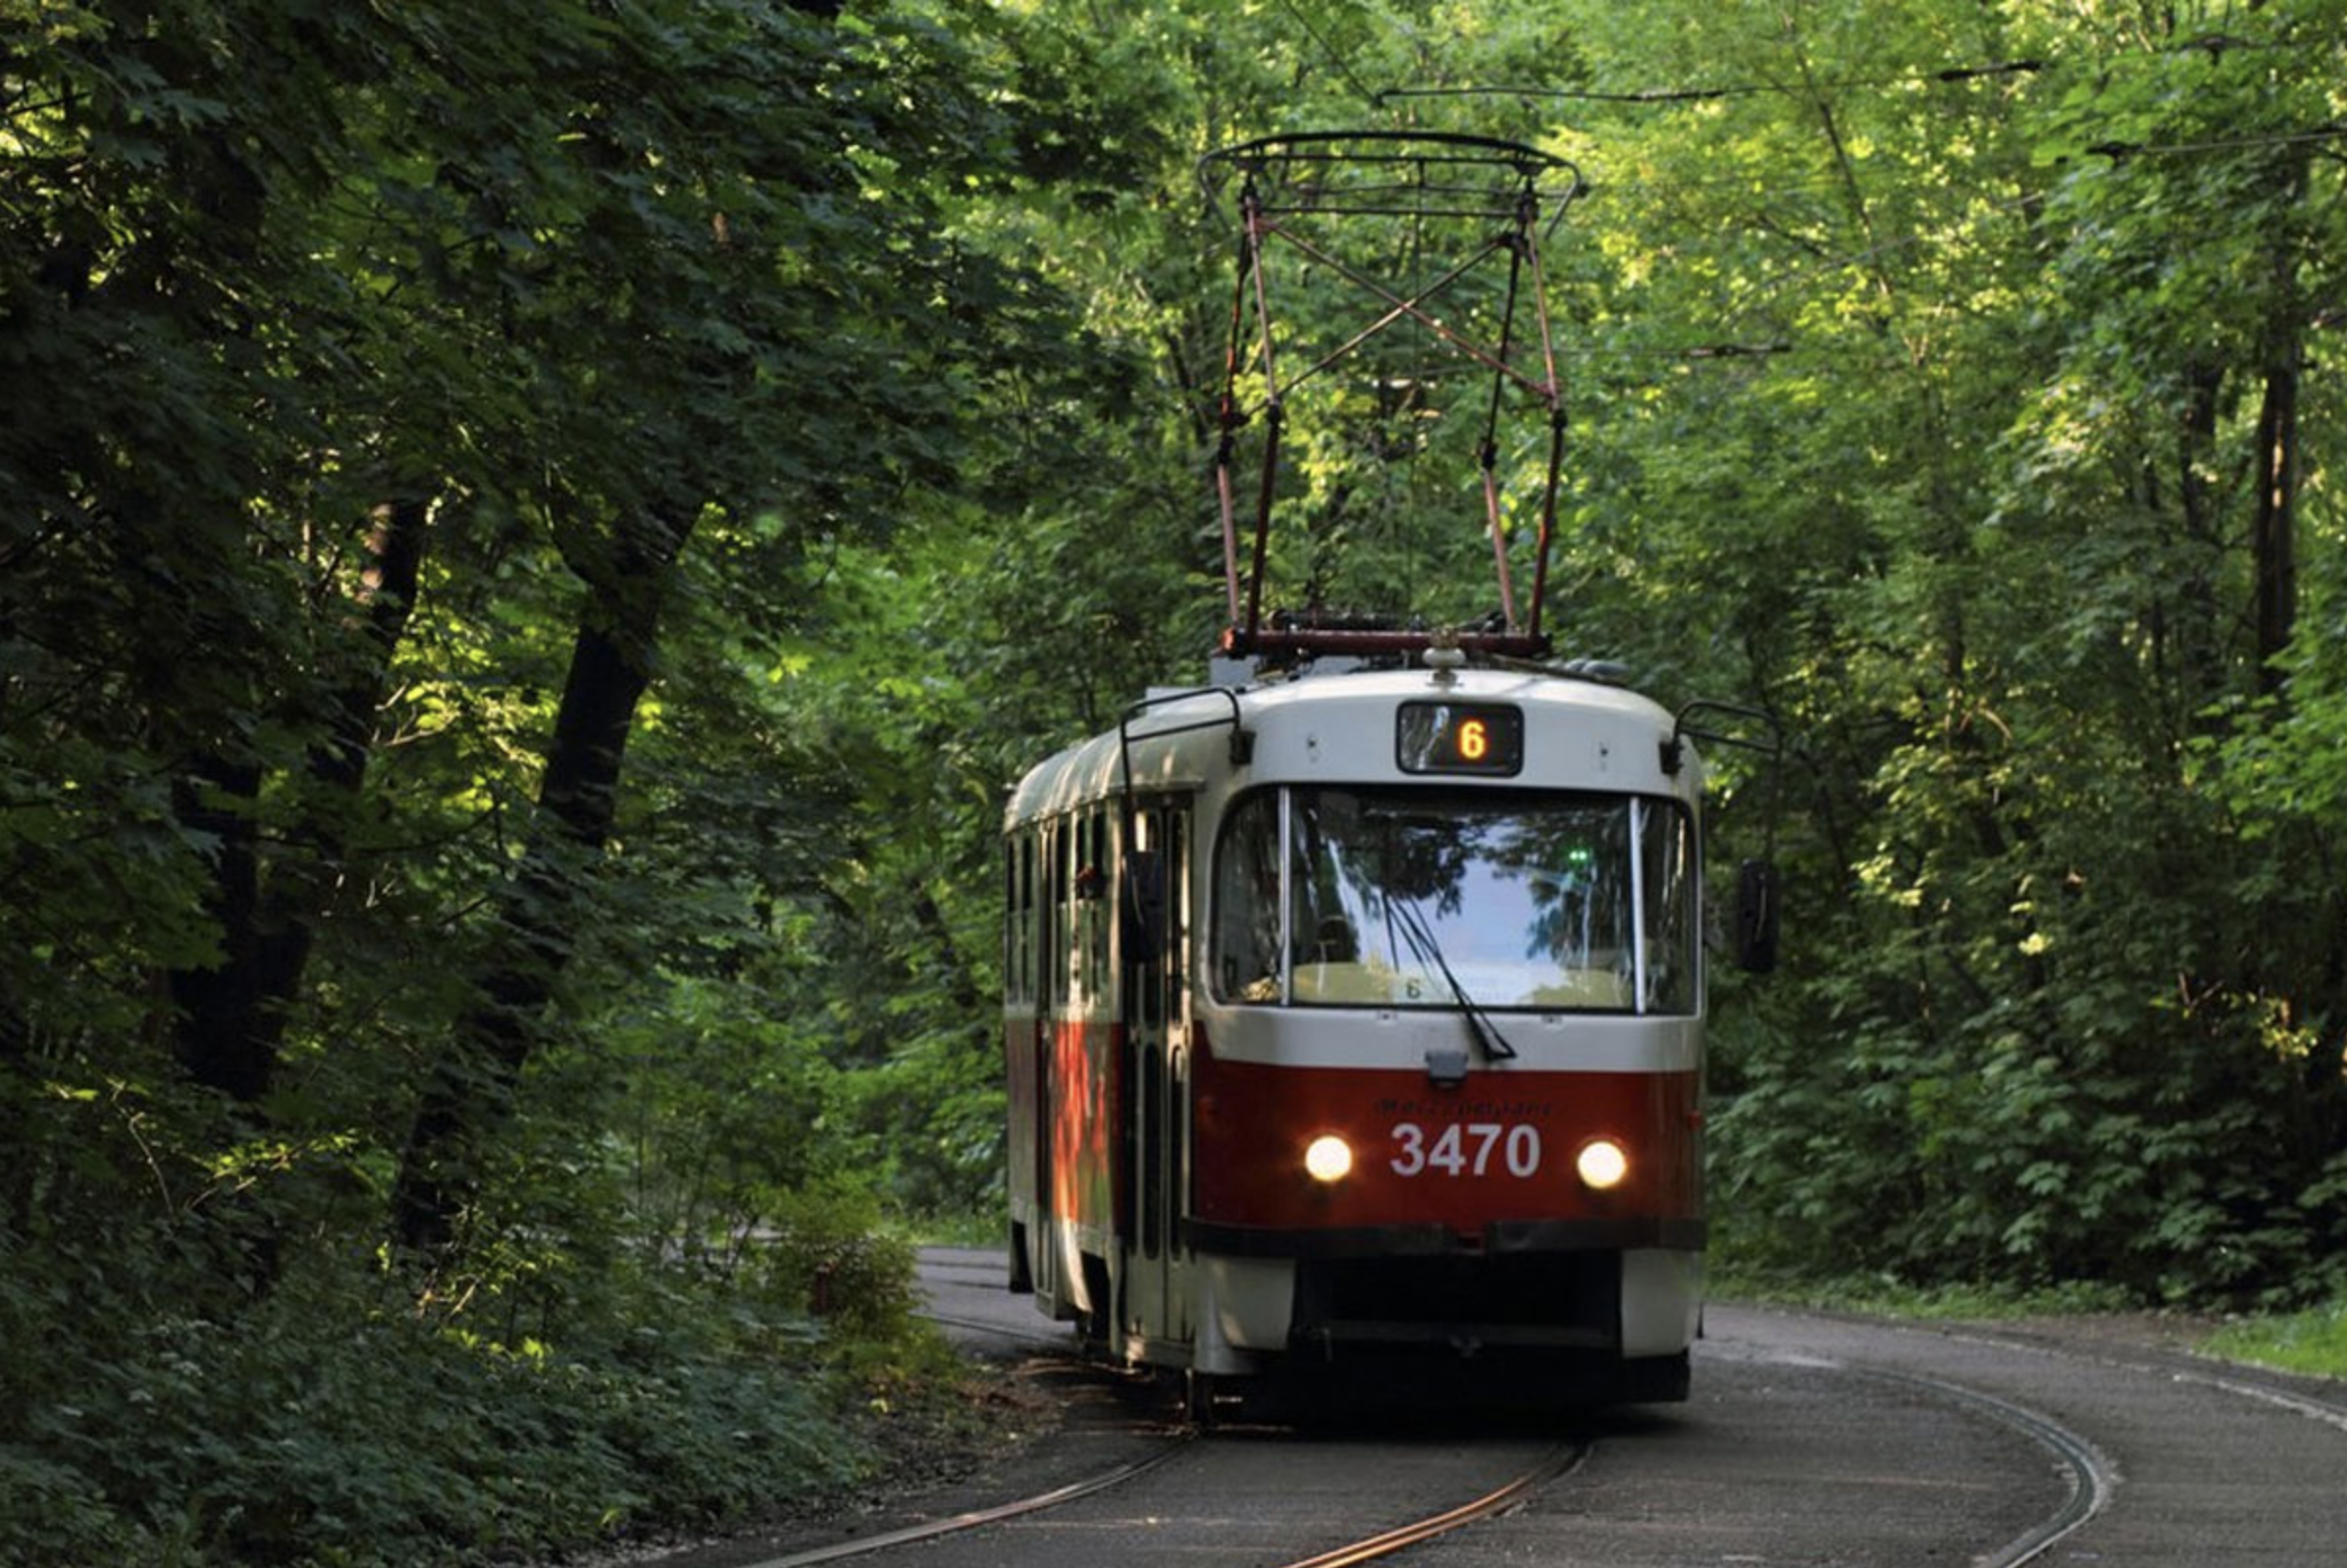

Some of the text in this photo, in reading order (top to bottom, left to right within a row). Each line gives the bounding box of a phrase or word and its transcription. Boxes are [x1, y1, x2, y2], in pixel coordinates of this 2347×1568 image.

[1460, 720, 1486, 759] 6
[1406, 978, 1421, 999] 6
[1389, 1123, 1541, 1177] 3470
